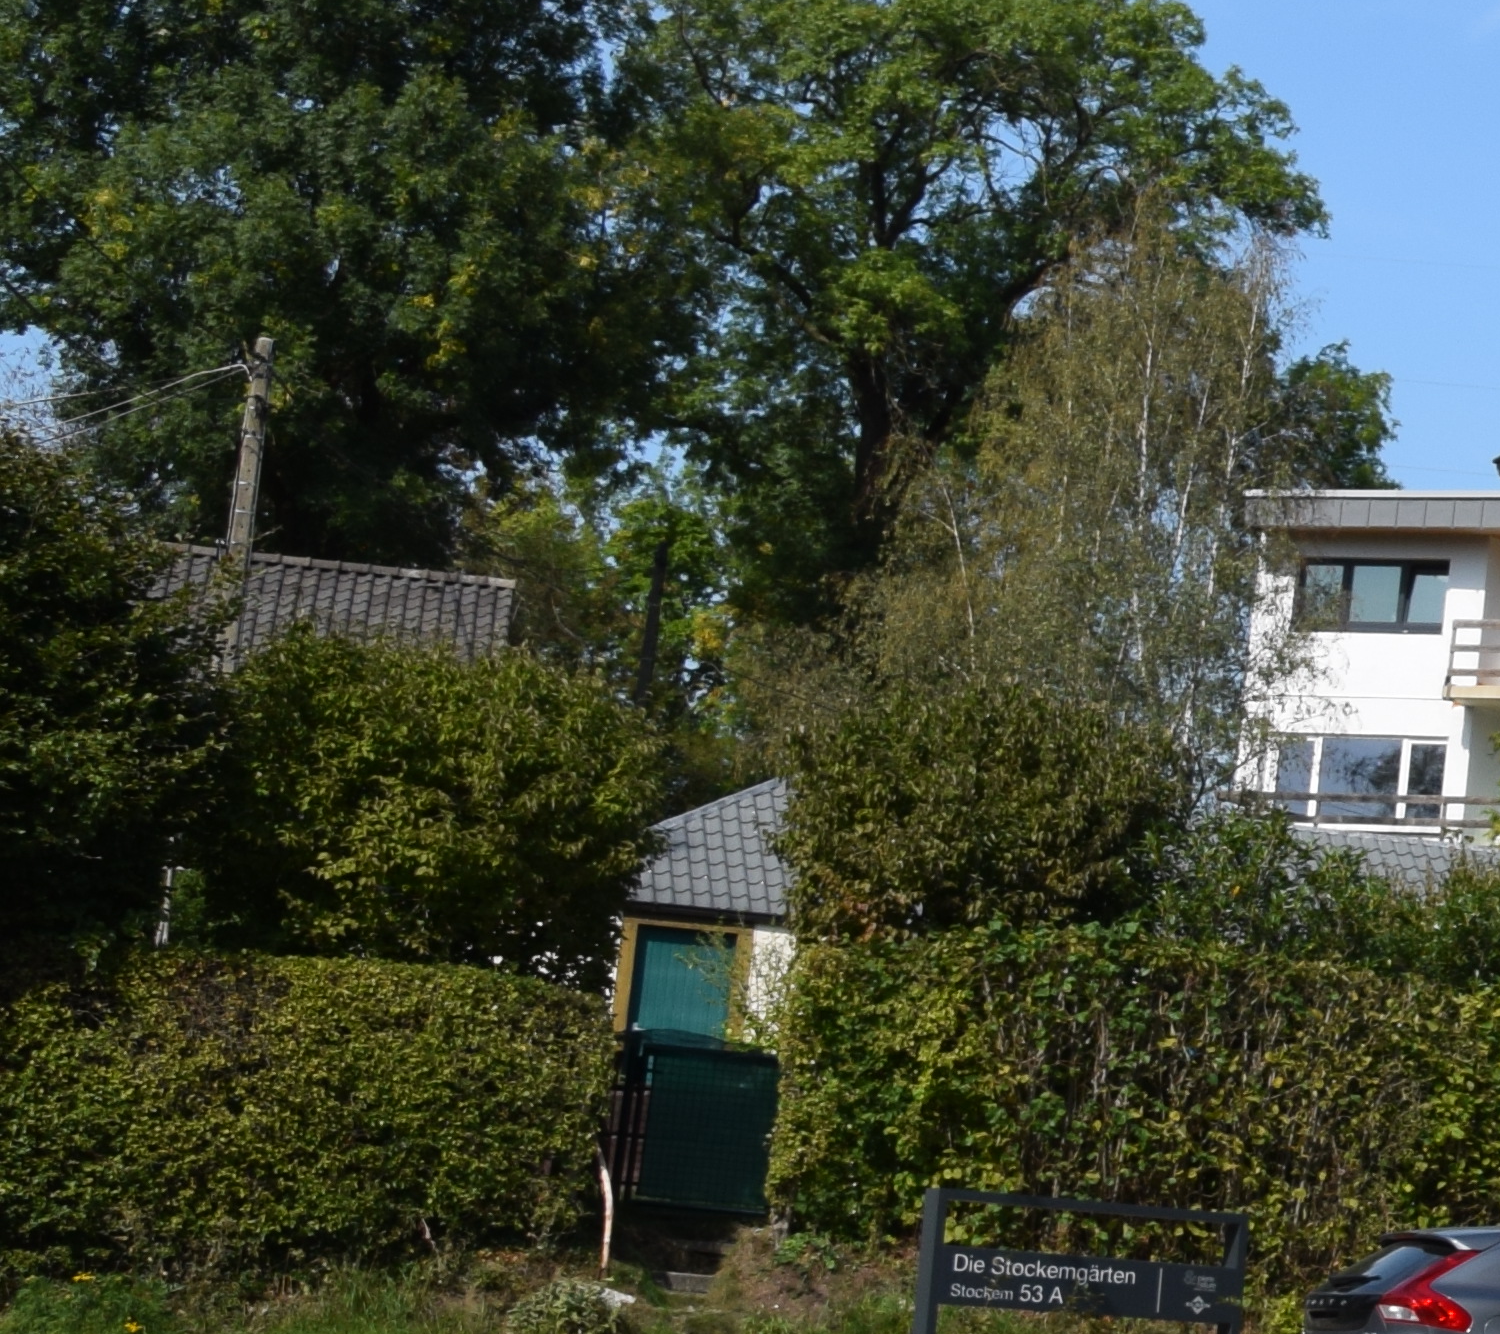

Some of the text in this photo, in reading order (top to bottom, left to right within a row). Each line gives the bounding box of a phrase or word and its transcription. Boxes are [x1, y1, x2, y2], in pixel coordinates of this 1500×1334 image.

[953, 1253, 1137, 1285] Die Stockemgärten
[950, 1283, 1064, 1305] Stockem 53 A
